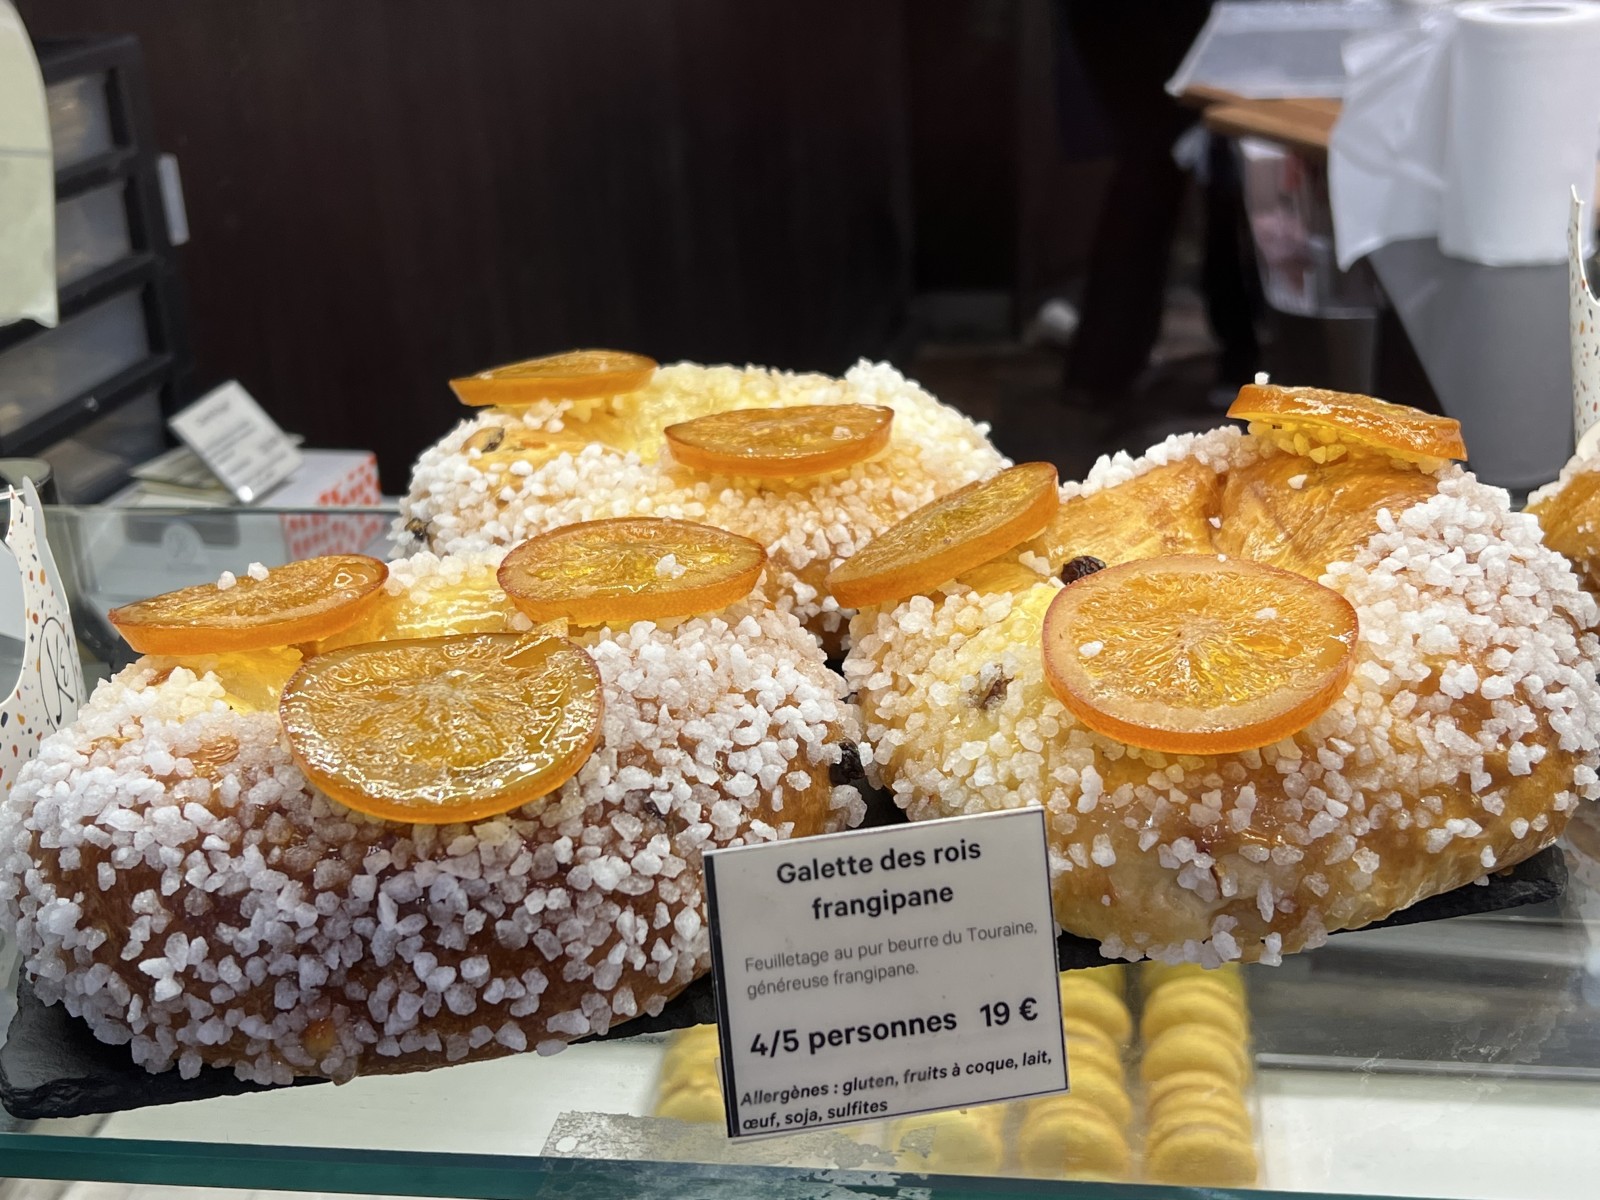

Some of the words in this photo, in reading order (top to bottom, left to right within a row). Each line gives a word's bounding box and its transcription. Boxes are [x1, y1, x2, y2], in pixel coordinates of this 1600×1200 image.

[776, 855, 874, 884] Galette
[879, 847, 926, 871] des
[933, 838, 981, 865] rois
[811, 886, 954, 920] frangipane
[744, 950, 830, 973] Feuilletage
[834, 947, 853, 961] au
[857, 942, 884, 961] pur
[887, 935, 939, 954] beurre
[942, 930, 963, 946] du
[966, 921, 1038, 942] Touraine,
[746, 974, 830, 1001] généreuse
[833, 963, 919, 985] frangipane.
[750, 1028, 800, 1058] 4/5
[808, 1012, 958, 1054] personnes
[979, 1001, 1011, 1028] 19
[1018, 997, 1039, 1022] €
[740, 1084, 829, 1107] Allergènes
[833, 1083, 839, 1095] :
[842, 1075, 899, 1096] gluten,
[903, 1066, 948, 1084] fruits
[951, 1062, 961, 1077] à
[965, 1058, 1019, 1075] coque,
[1022, 1050, 1052, 1067] lait,
[742, 1111, 782, 1132] œuf,
[784, 1107, 824, 1127] soja,
[827, 1100, 890, 1122] sulfites
